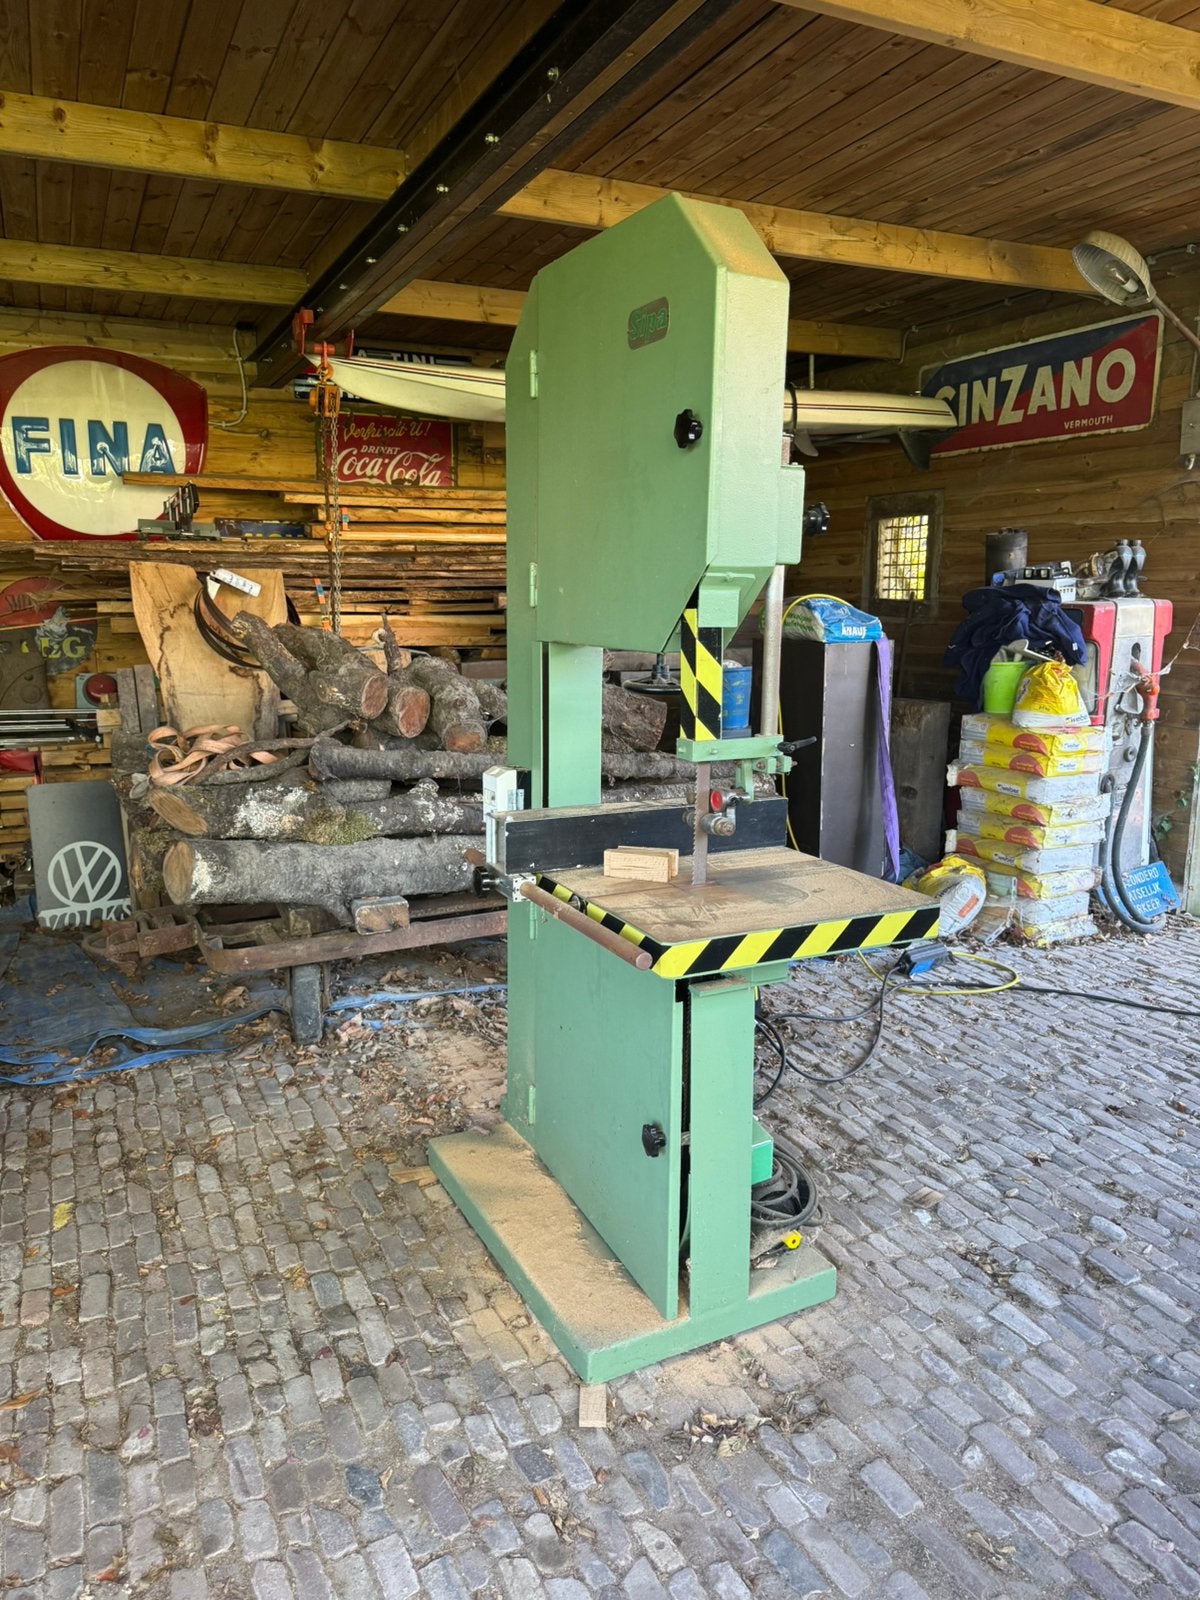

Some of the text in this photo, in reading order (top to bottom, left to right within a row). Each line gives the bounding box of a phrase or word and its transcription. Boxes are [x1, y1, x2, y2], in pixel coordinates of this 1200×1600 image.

[1063, 414, 1114, 430] VERMOUTH
[11, 416, 176, 478] FINA
[360, 444, 401, 455] DRINKT
[841, 622, 867, 639] KNAUF
